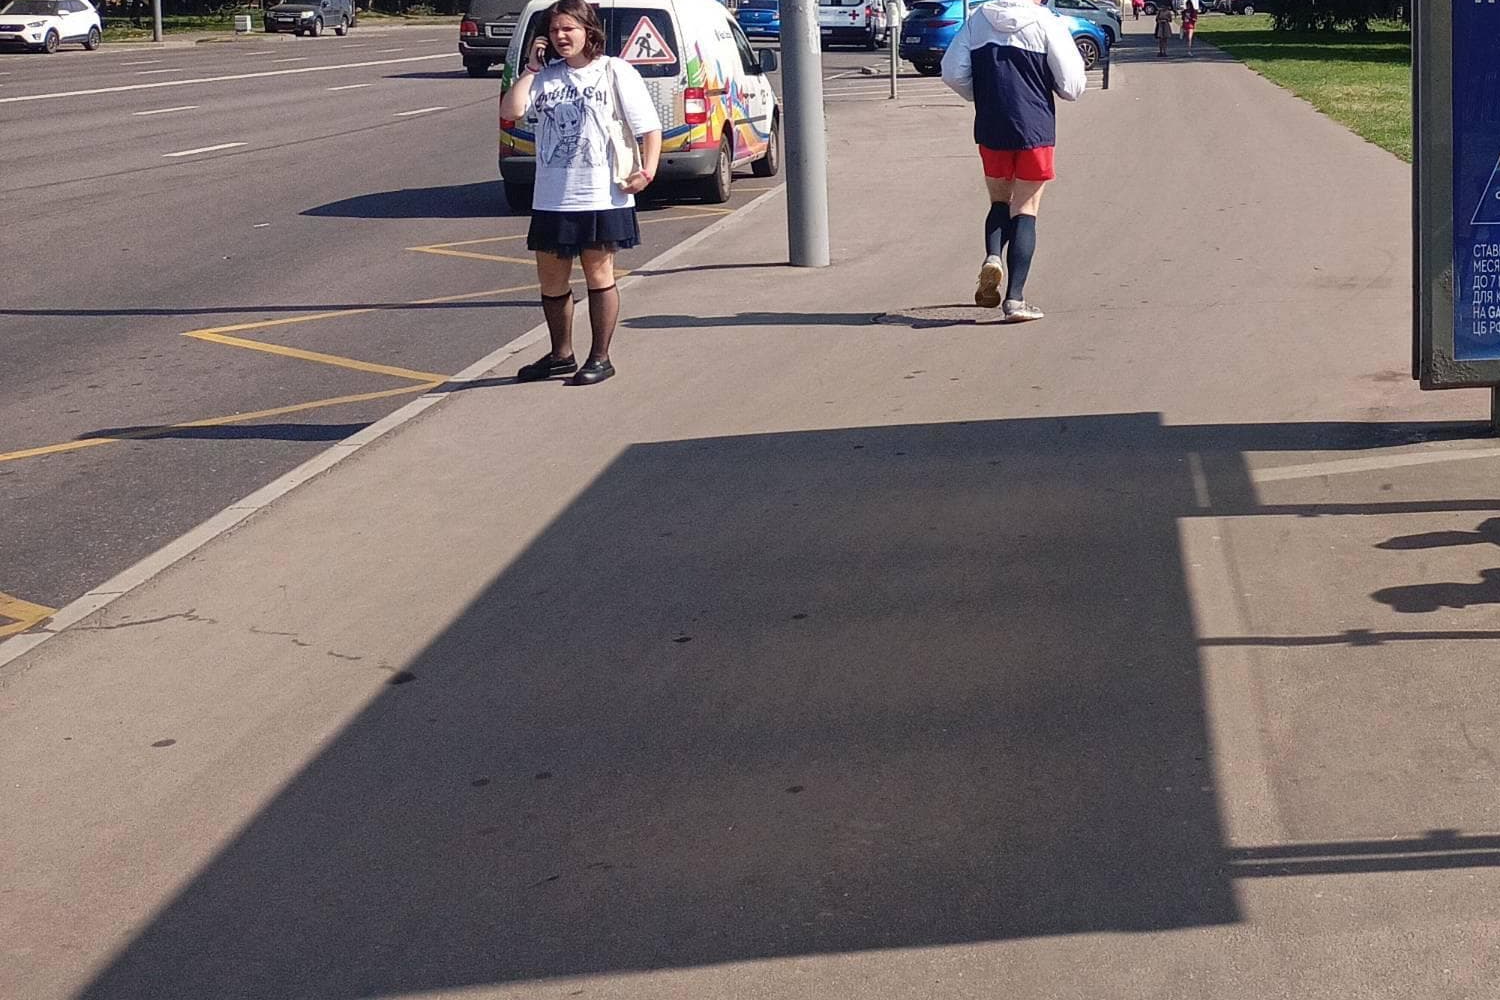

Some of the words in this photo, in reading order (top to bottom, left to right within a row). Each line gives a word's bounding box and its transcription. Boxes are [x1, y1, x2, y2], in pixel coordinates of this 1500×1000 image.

[1473, 275, 1488, 290] ДО
[1490, 275, 1496, 287] 7
[1473, 290, 1493, 305] ДЛЯ
[1473, 305, 1486, 319] НА
[1473, 321, 1487, 336] ЦБ
